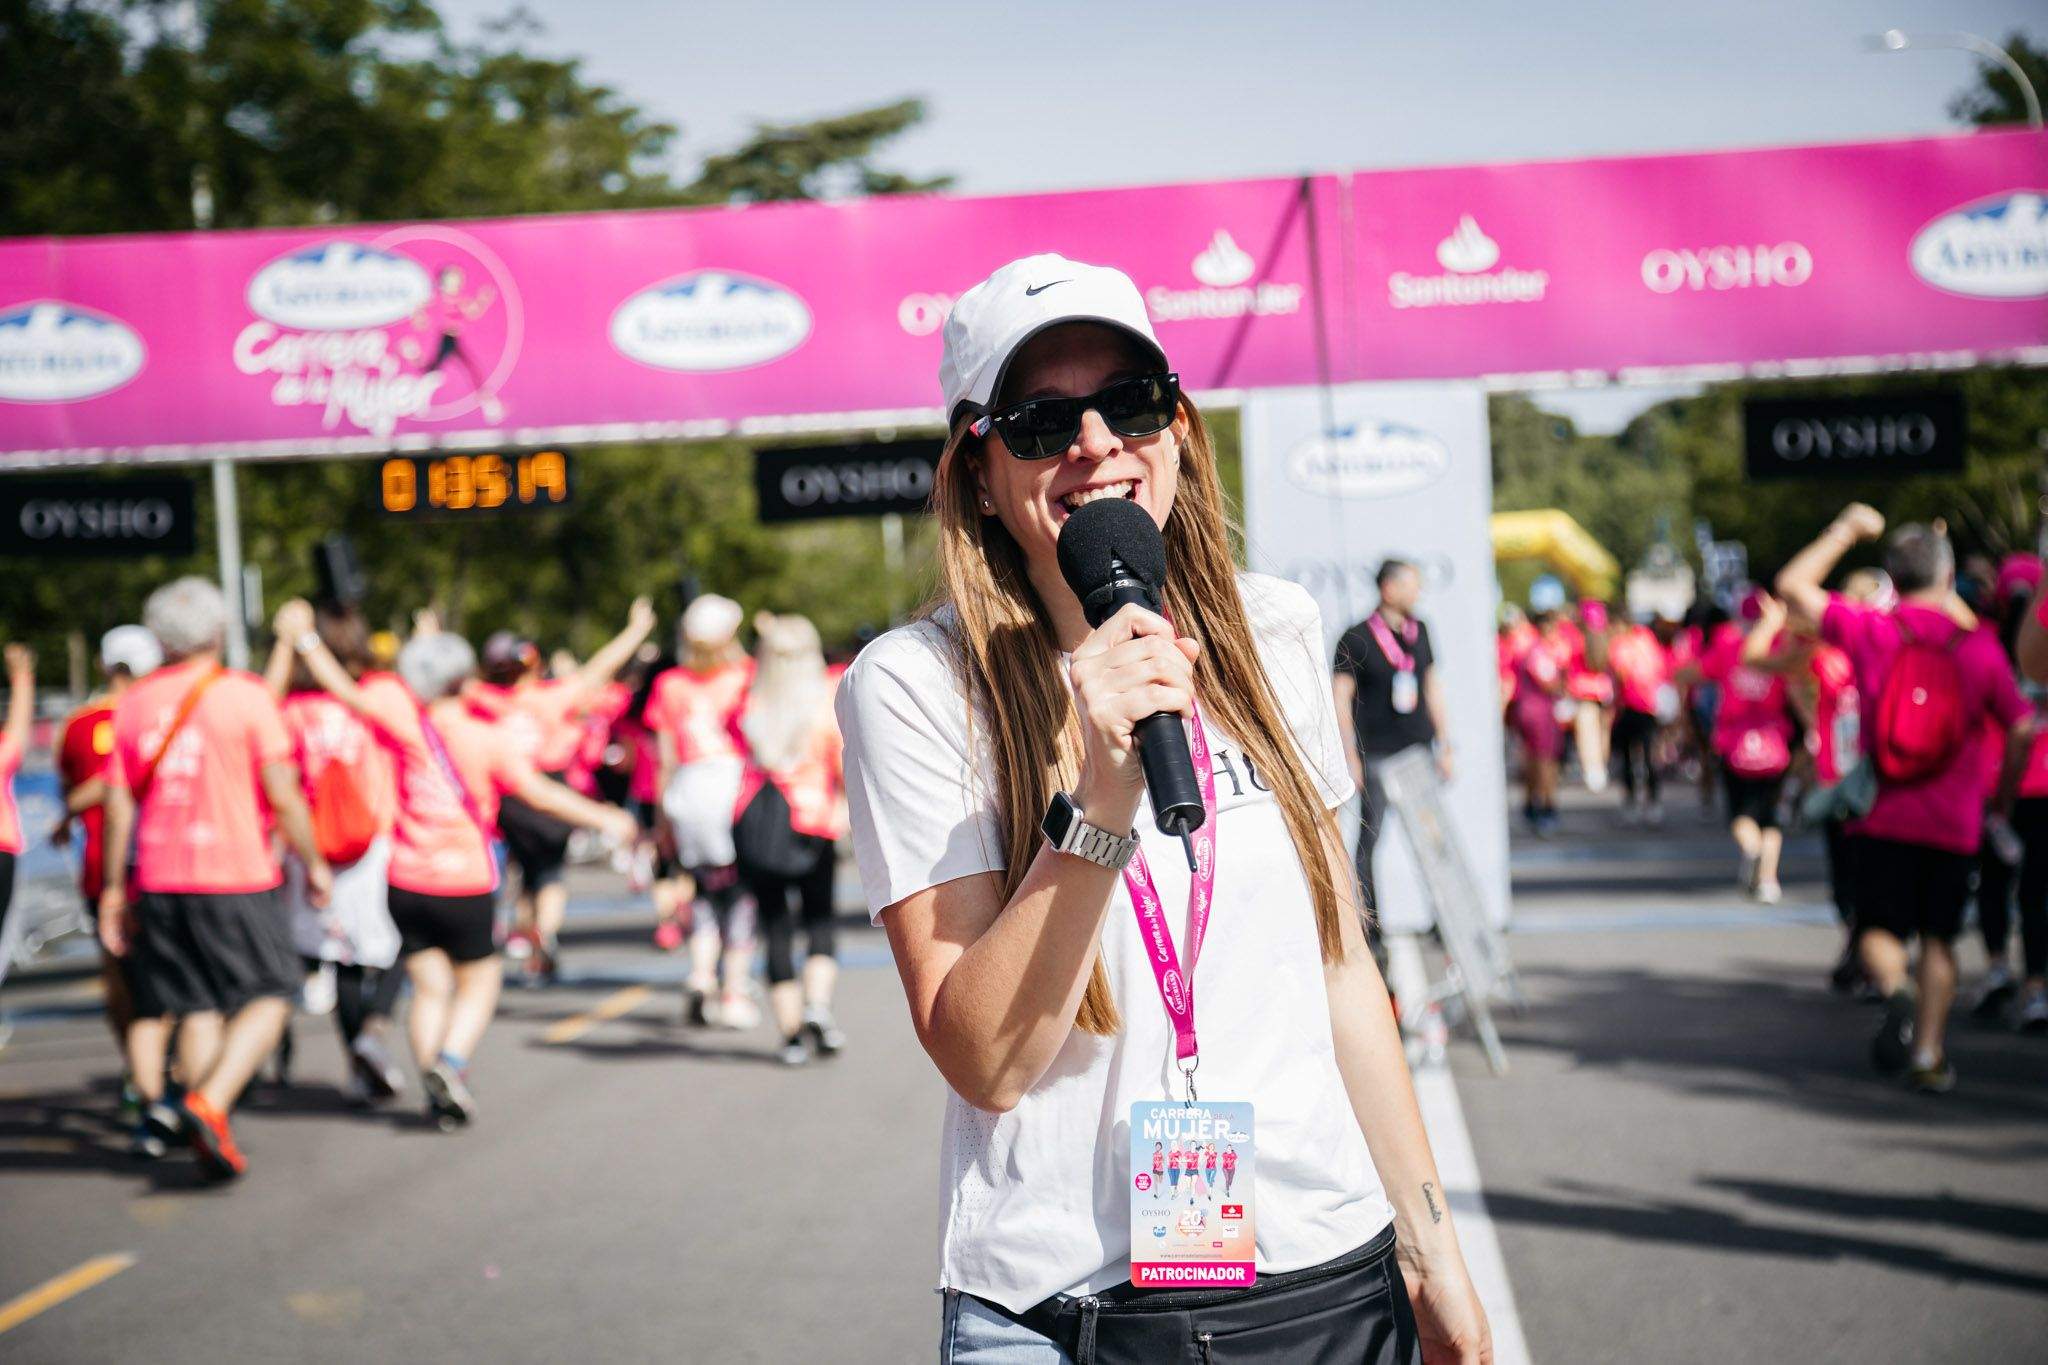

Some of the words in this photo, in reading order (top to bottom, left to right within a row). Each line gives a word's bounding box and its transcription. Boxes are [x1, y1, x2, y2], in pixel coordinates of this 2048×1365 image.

[1641, 241, 1813, 293] OYSHO
[1389, 266, 1549, 309] Santander
[1772, 411, 1936, 462] OYSHO
[780, 457, 935, 507] OYSHO
[20, 498, 174, 541] OYSHO
[1140, 895, 1159, 918] Mujer
[1152, 928, 1169, 962] Carrera
[1143, 1119, 1230, 1140] MUJER
[1150, 1107, 1212, 1119] CARRERA
[1141, 1209, 1171, 1217] OYSHO
[1141, 1267, 1245, 1281] PATROCINADOR
